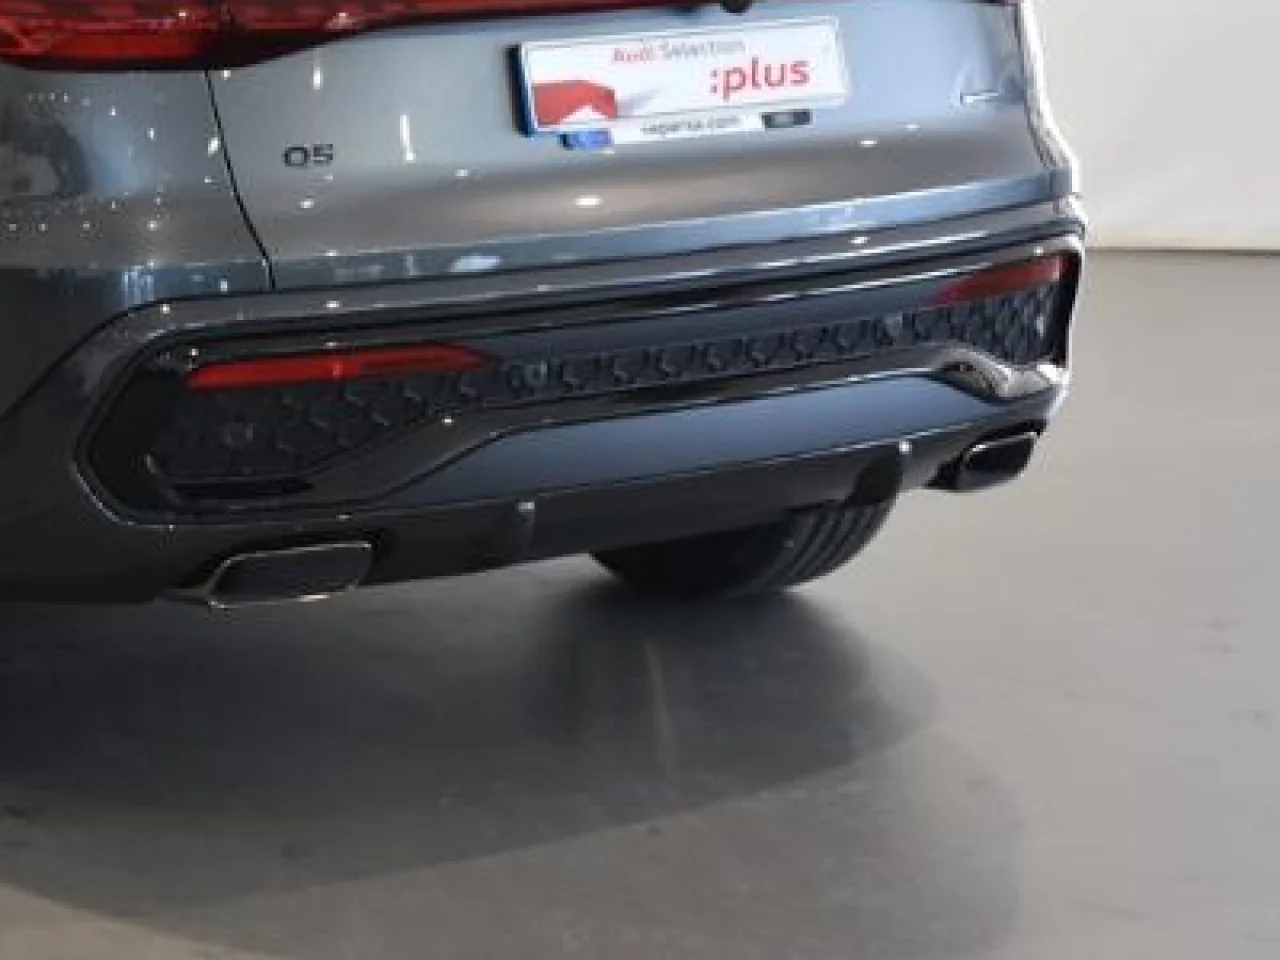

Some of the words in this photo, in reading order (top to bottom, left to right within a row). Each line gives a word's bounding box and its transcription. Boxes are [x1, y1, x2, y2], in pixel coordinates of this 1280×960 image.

[612, 41, 654, 64] Audi
[659, 37, 747, 59] Selection
[709, 57, 811, 101] :plus
